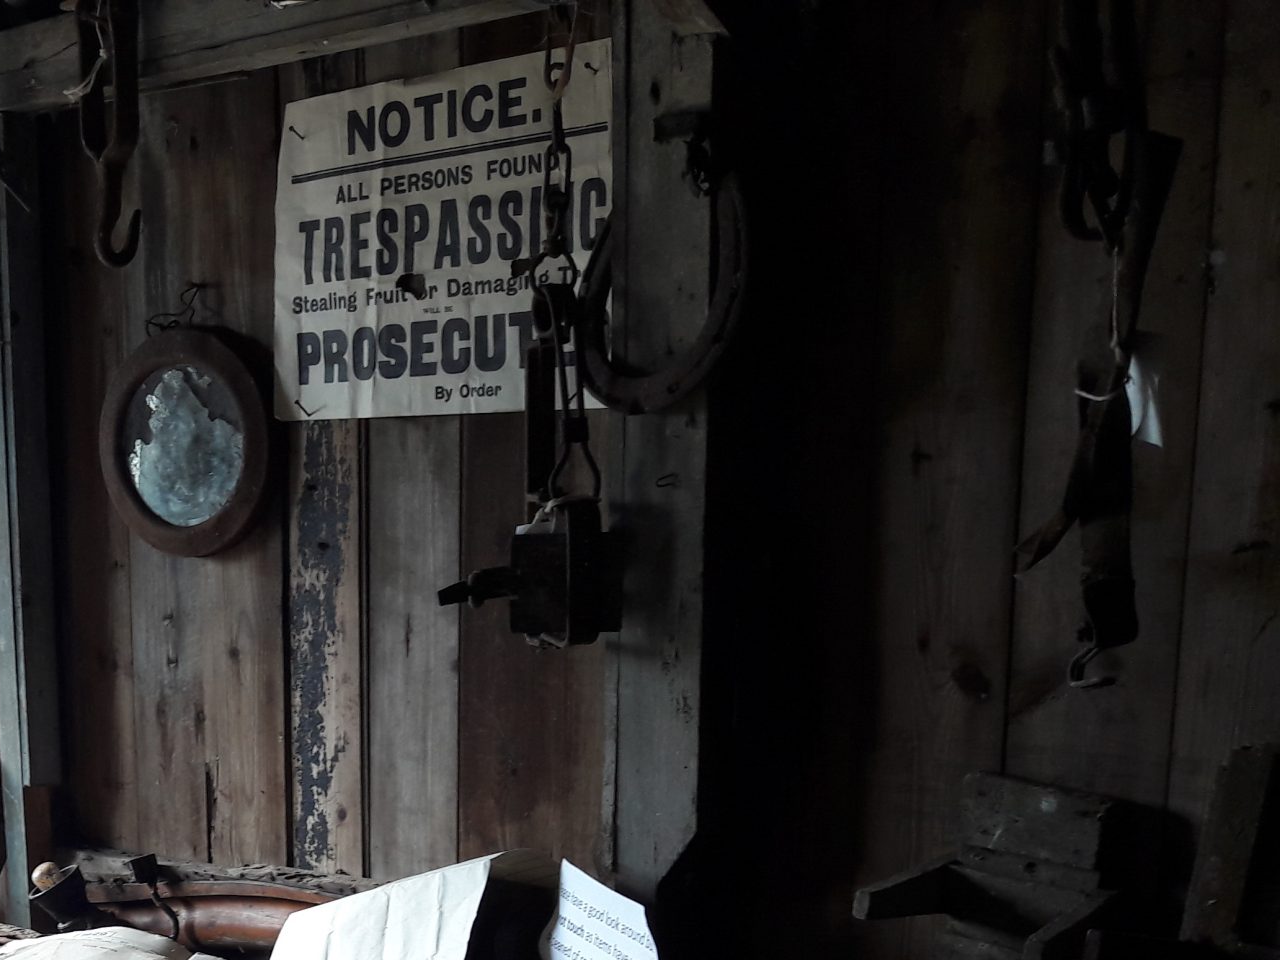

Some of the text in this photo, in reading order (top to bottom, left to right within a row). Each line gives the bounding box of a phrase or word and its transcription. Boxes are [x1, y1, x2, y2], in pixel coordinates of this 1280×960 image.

[347, 76, 542, 156] NOTICE.
[335, 181, 370, 205] ALL
[380, 164, 473, 197] PERSONS
[292, 289, 358, 315] Stealing
[365, 285, 409, 305] Fruit
[434, 383, 502, 402] By Order
[587, 905, 606, 922] good
[605, 911, 620, 931] look
[620, 923, 646, 946] around
